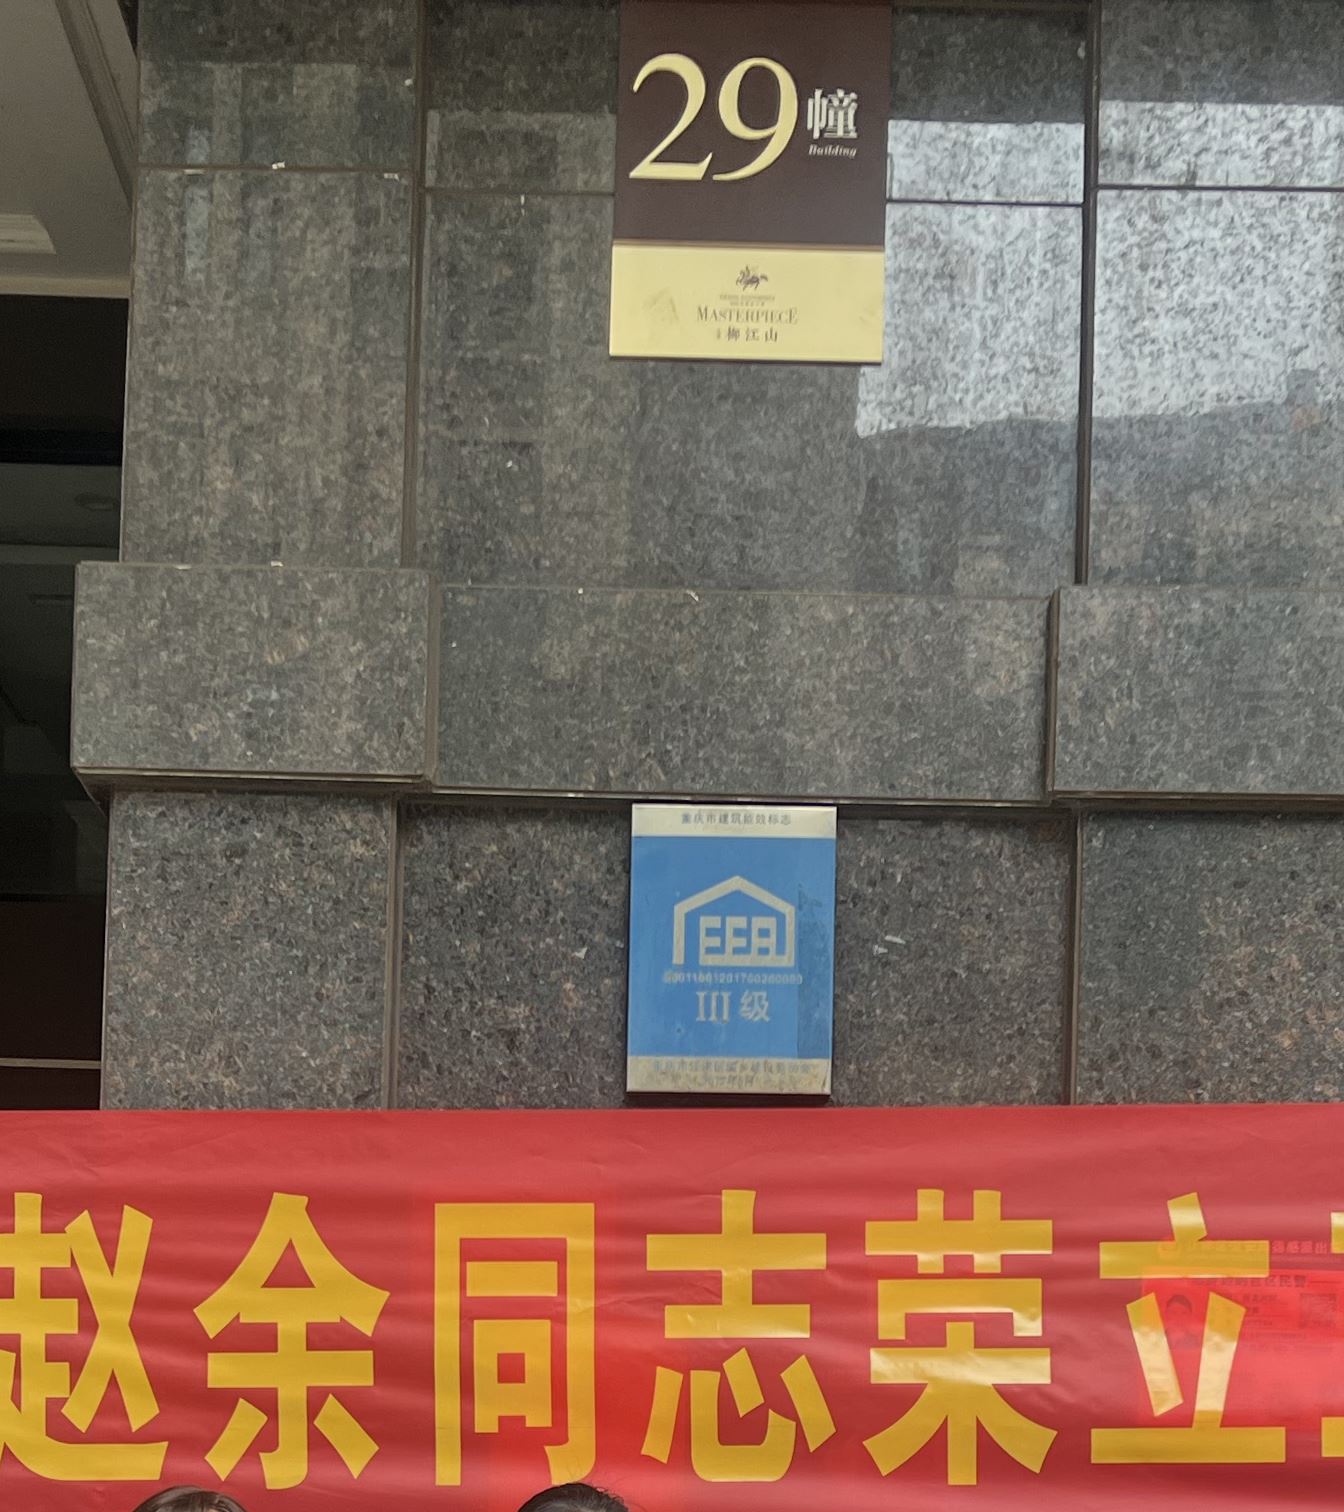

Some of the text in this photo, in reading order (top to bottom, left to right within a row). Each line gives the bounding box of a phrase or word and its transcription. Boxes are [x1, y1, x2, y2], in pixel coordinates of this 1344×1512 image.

[629, 53, 858, 181] 29 幢
[808, 144, 857, 158] Building
[697, 305, 798, 324] MASTERPIECE
